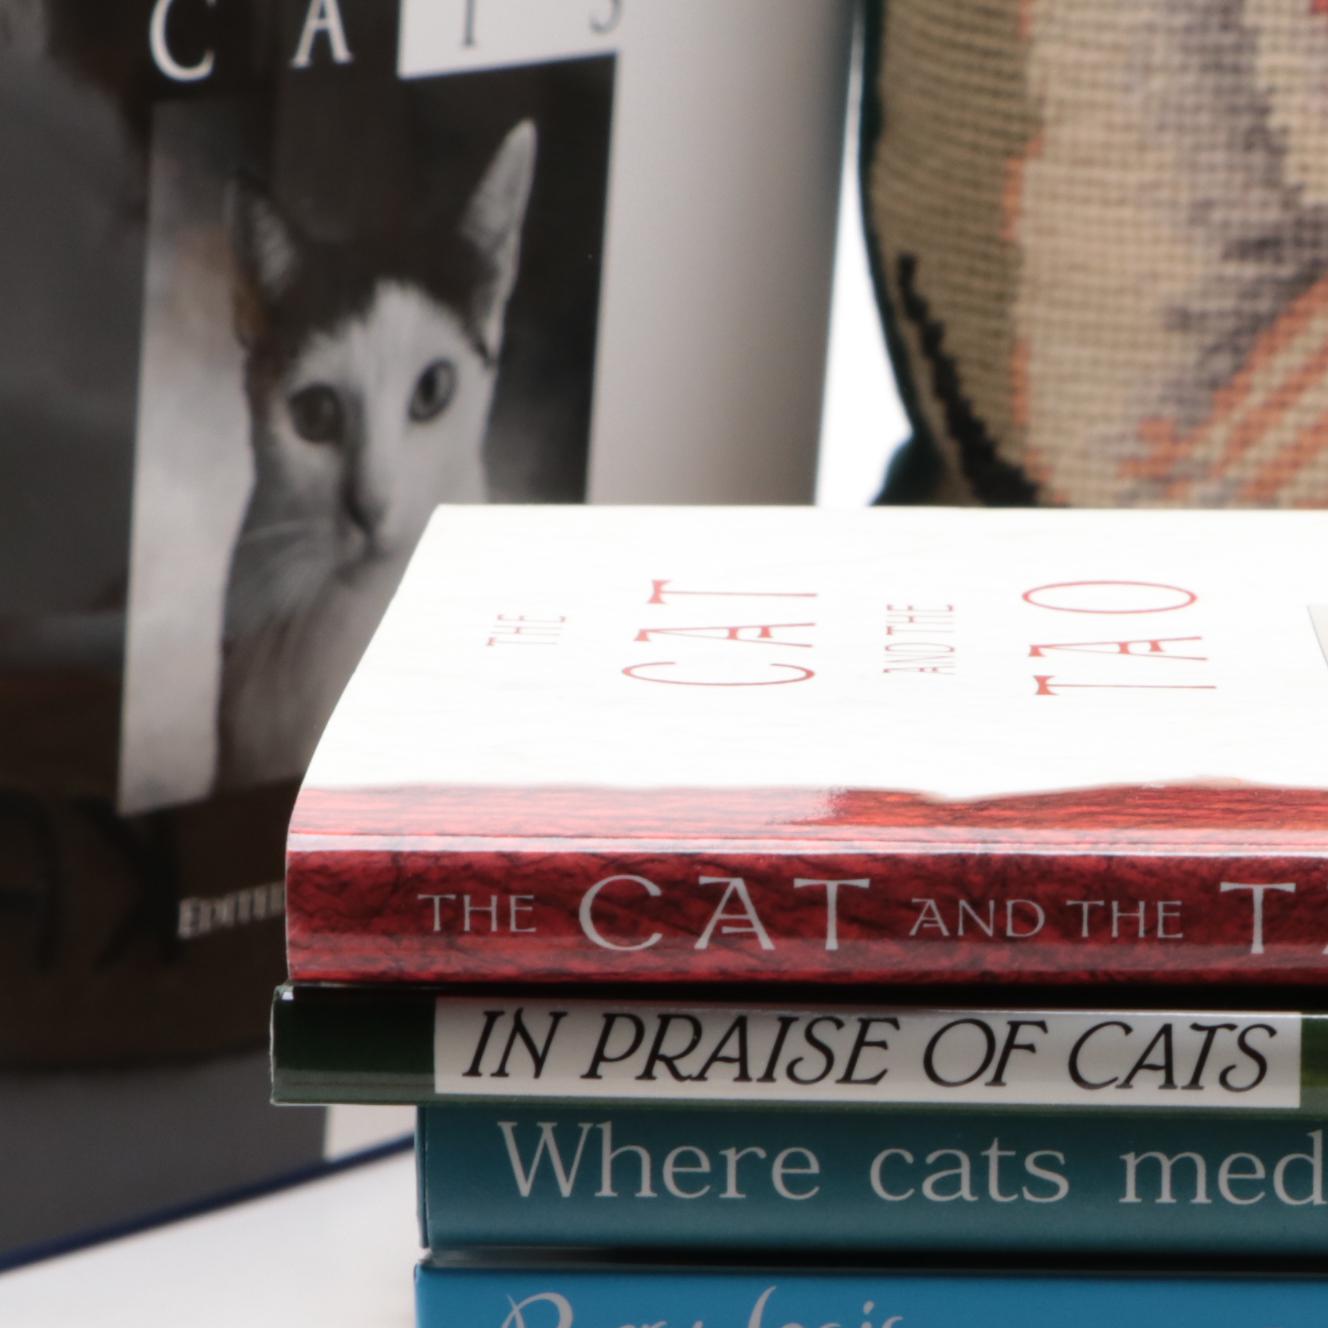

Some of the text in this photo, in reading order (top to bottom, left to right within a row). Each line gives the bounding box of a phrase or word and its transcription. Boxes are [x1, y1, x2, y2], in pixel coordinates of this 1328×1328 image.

[621, 580, 817, 686] CAT
[1022, 580, 1216, 695] TAO
[418, 894, 536, 932] THE
[579, 874, 870, 951] CAT
[909, 898, 1045, 938] AND
[1066, 900, 1183, 939] THE
[461, 1007, 1278, 1093] IN PRAISE OF CATS
[497, 1121, 821, 1200] Where
[869, 1137, 1070, 1203] cats
